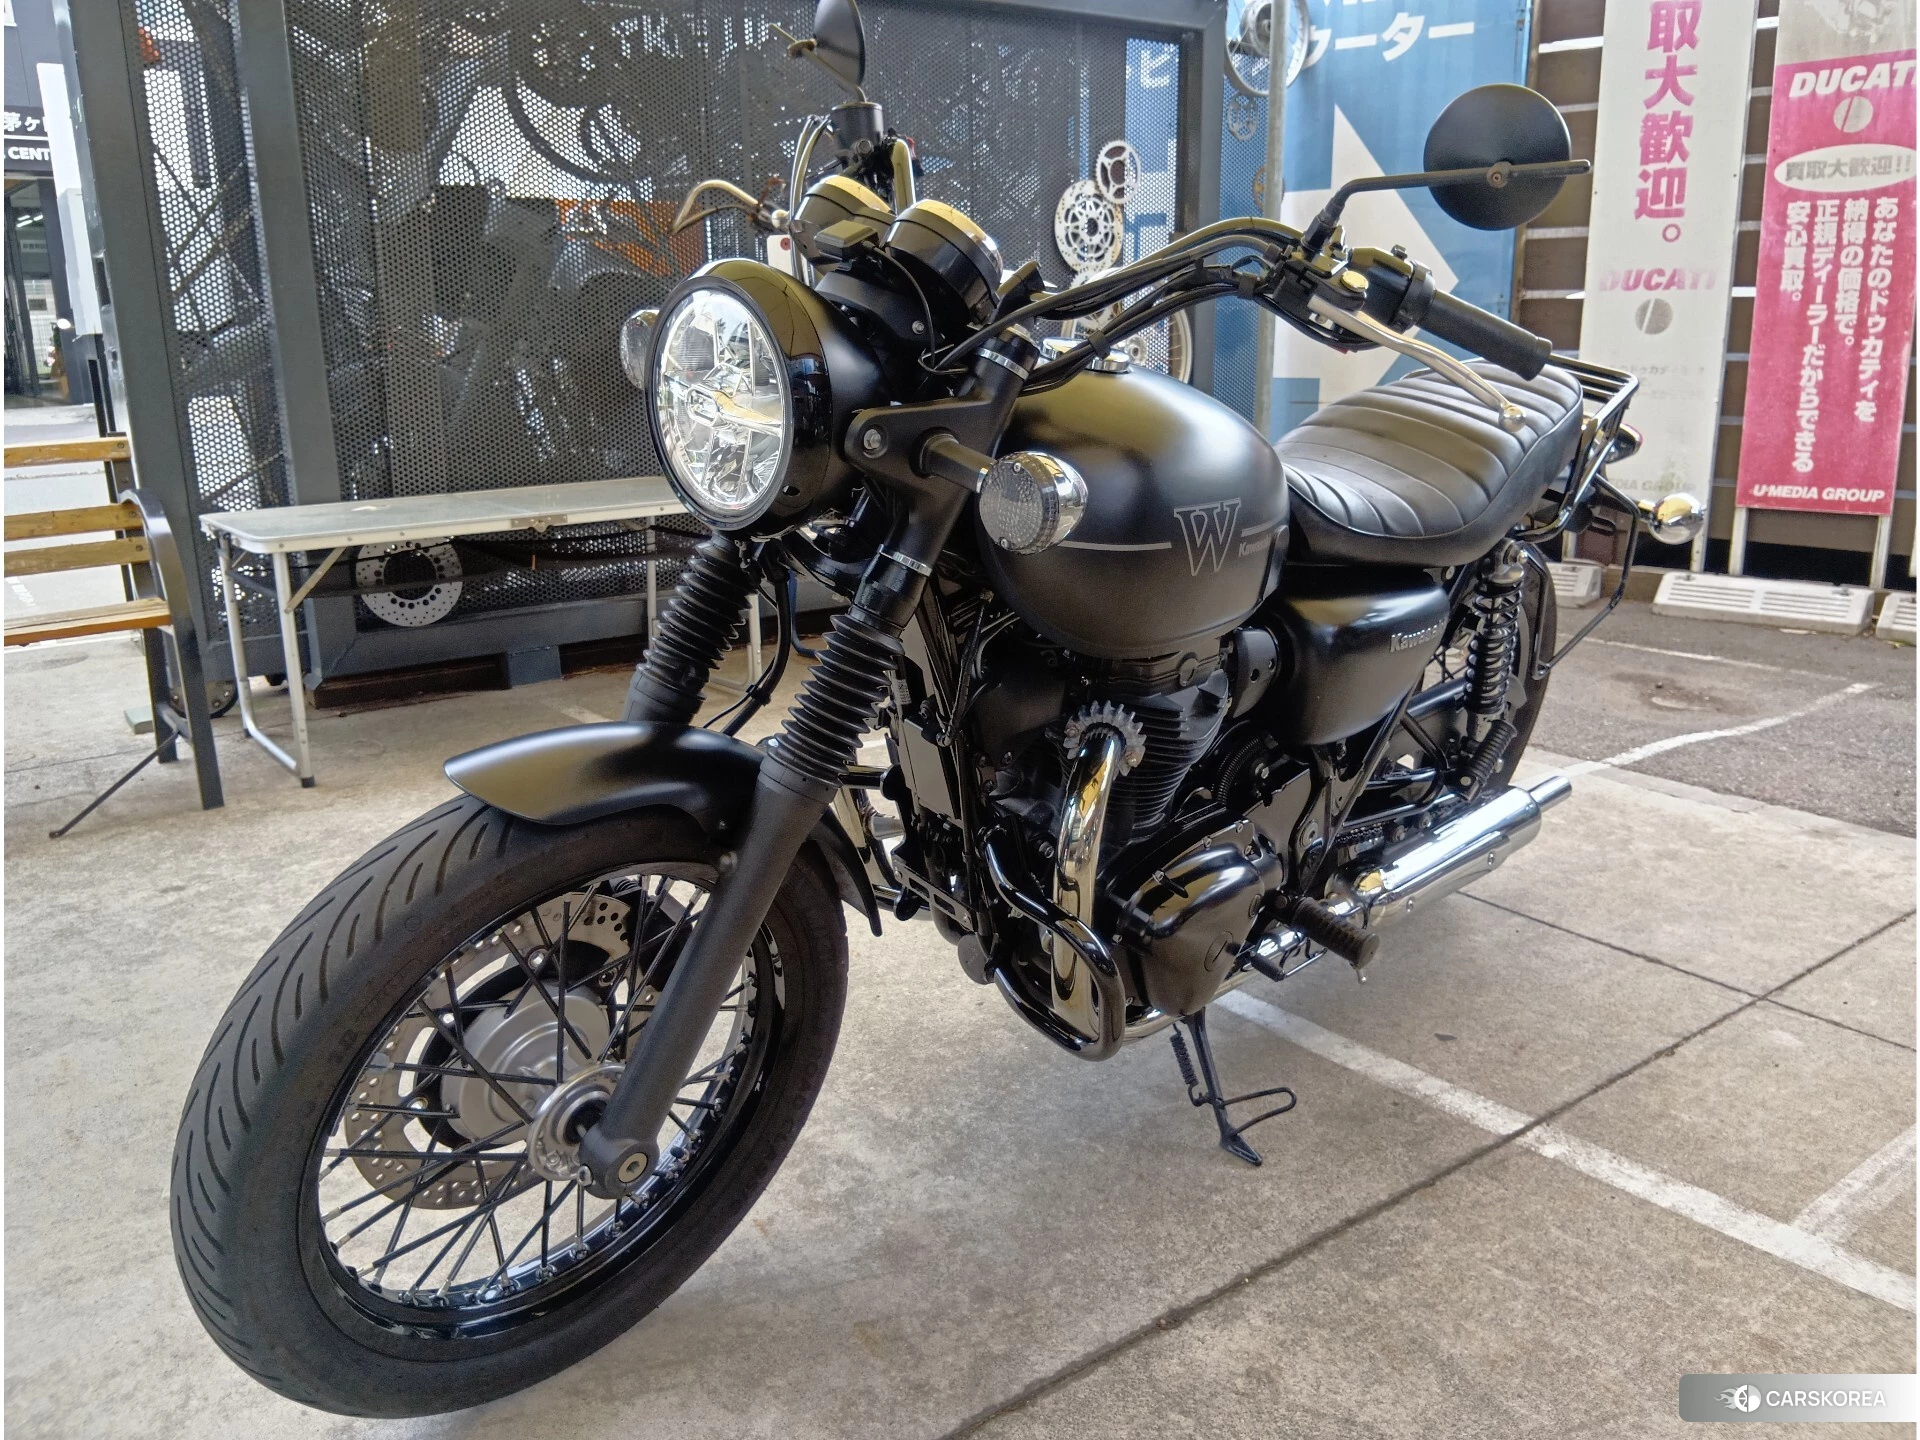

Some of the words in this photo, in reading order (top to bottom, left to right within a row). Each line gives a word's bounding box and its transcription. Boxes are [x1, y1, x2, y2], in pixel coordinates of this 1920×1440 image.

[1599, 267, 1718, 292] DUCATI
[1822, 487, 1885, 502] GROUP
[1173, 497, 1241, 577] W
